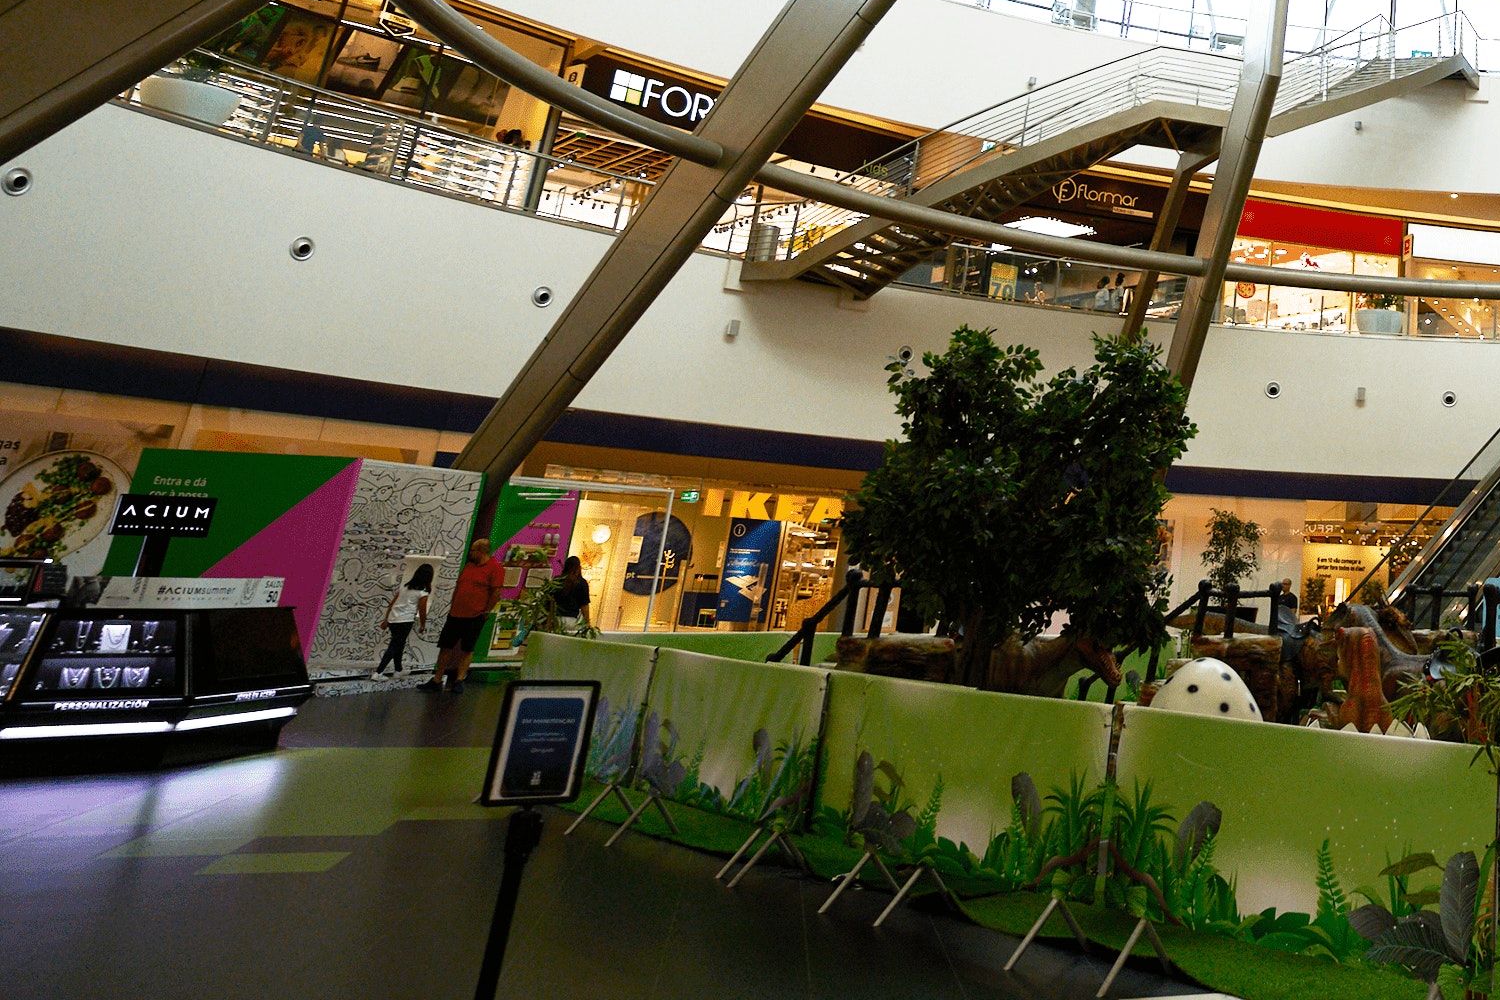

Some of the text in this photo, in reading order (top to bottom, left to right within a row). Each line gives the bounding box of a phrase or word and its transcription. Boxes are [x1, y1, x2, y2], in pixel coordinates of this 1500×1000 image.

[641, 78, 718, 122] FOR
[1077, 184, 1139, 208] flormar
[153, 475, 207, 487] Entra e dá
[122, 504, 210, 519] ACIUM
[702, 488, 845, 524] IKEA
[53, 700, 150, 711] PERSONALIZACIÓN
